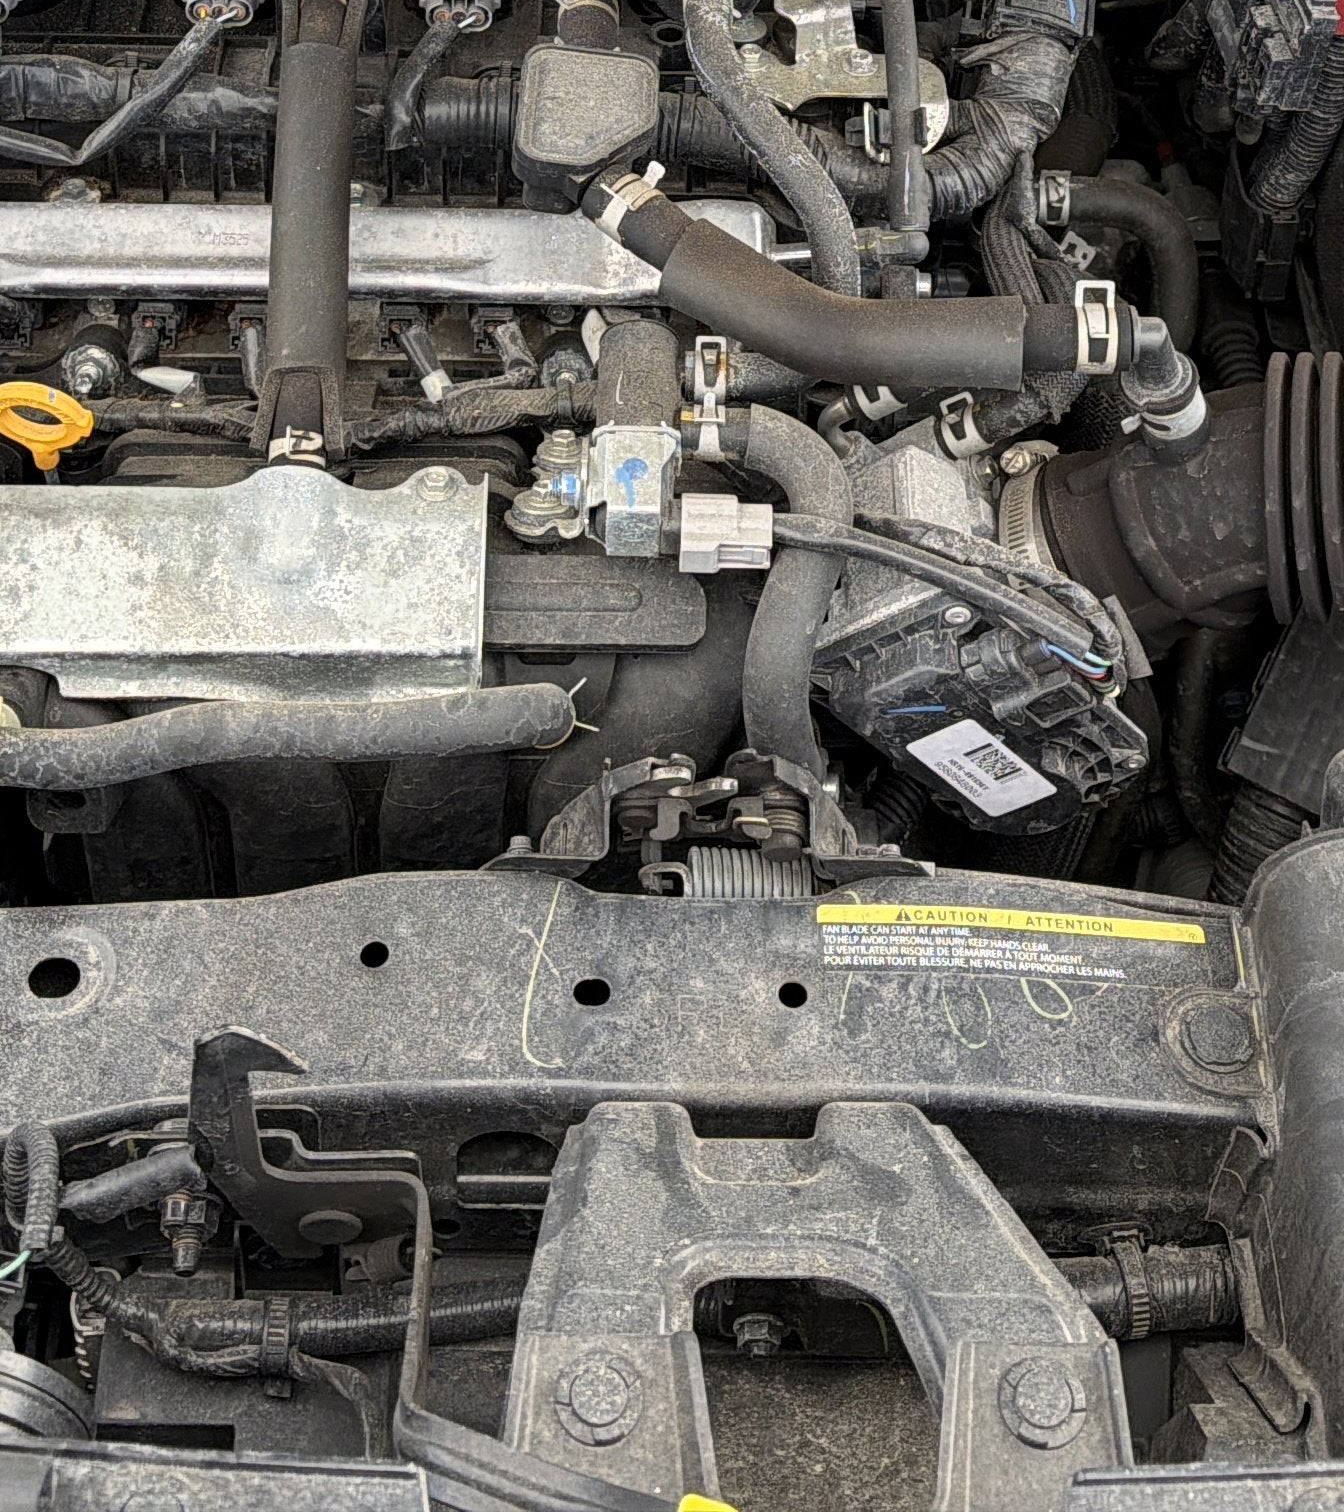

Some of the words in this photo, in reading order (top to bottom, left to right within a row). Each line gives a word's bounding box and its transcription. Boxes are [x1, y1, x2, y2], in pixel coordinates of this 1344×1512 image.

[822, 925, 840, 934] FAN
[841, 925, 869, 934] BLADE
[870, 926, 889, 934] CAN
[891, 926, 917, 935] START
[918, 926, 929, 935] AT
[913, 909, 989, 923] CAUTION
[1025, 916, 1114, 932] ATTENTION
[823, 935, 836, 944] TO
[837, 935, 858, 944] HELP
[860, 936, 888, 945] AVOID
[889, 936, 934, 946] PERSONAL
[968, 938, 989, 947] KEEP
[990, 939, 1021, 950] HANDS
[823, 945, 835, 954] LE
[836, 945, 899, 955] VENTILATEUR
[900, 946, 935, 957] RISQUE
[937, 947, 950, 956] DE
[951, 947, 1003, 959] DÉMARRER
[1014, 951, 1039, 961] TOUT
[1040, 954, 1086, 965] MOMENT.
[823, 956, 852, 965] POUR
[853, 955, 885, 966] ÉVITER
[886, 956, 918, 967] TOUTE
[969, 959, 983, 968] NE
[1018, 963, 1076, 975] APPROCHER
[1076, 967, 1093, 976] LES
[1093, 968, 1128, 979] MAINS.
